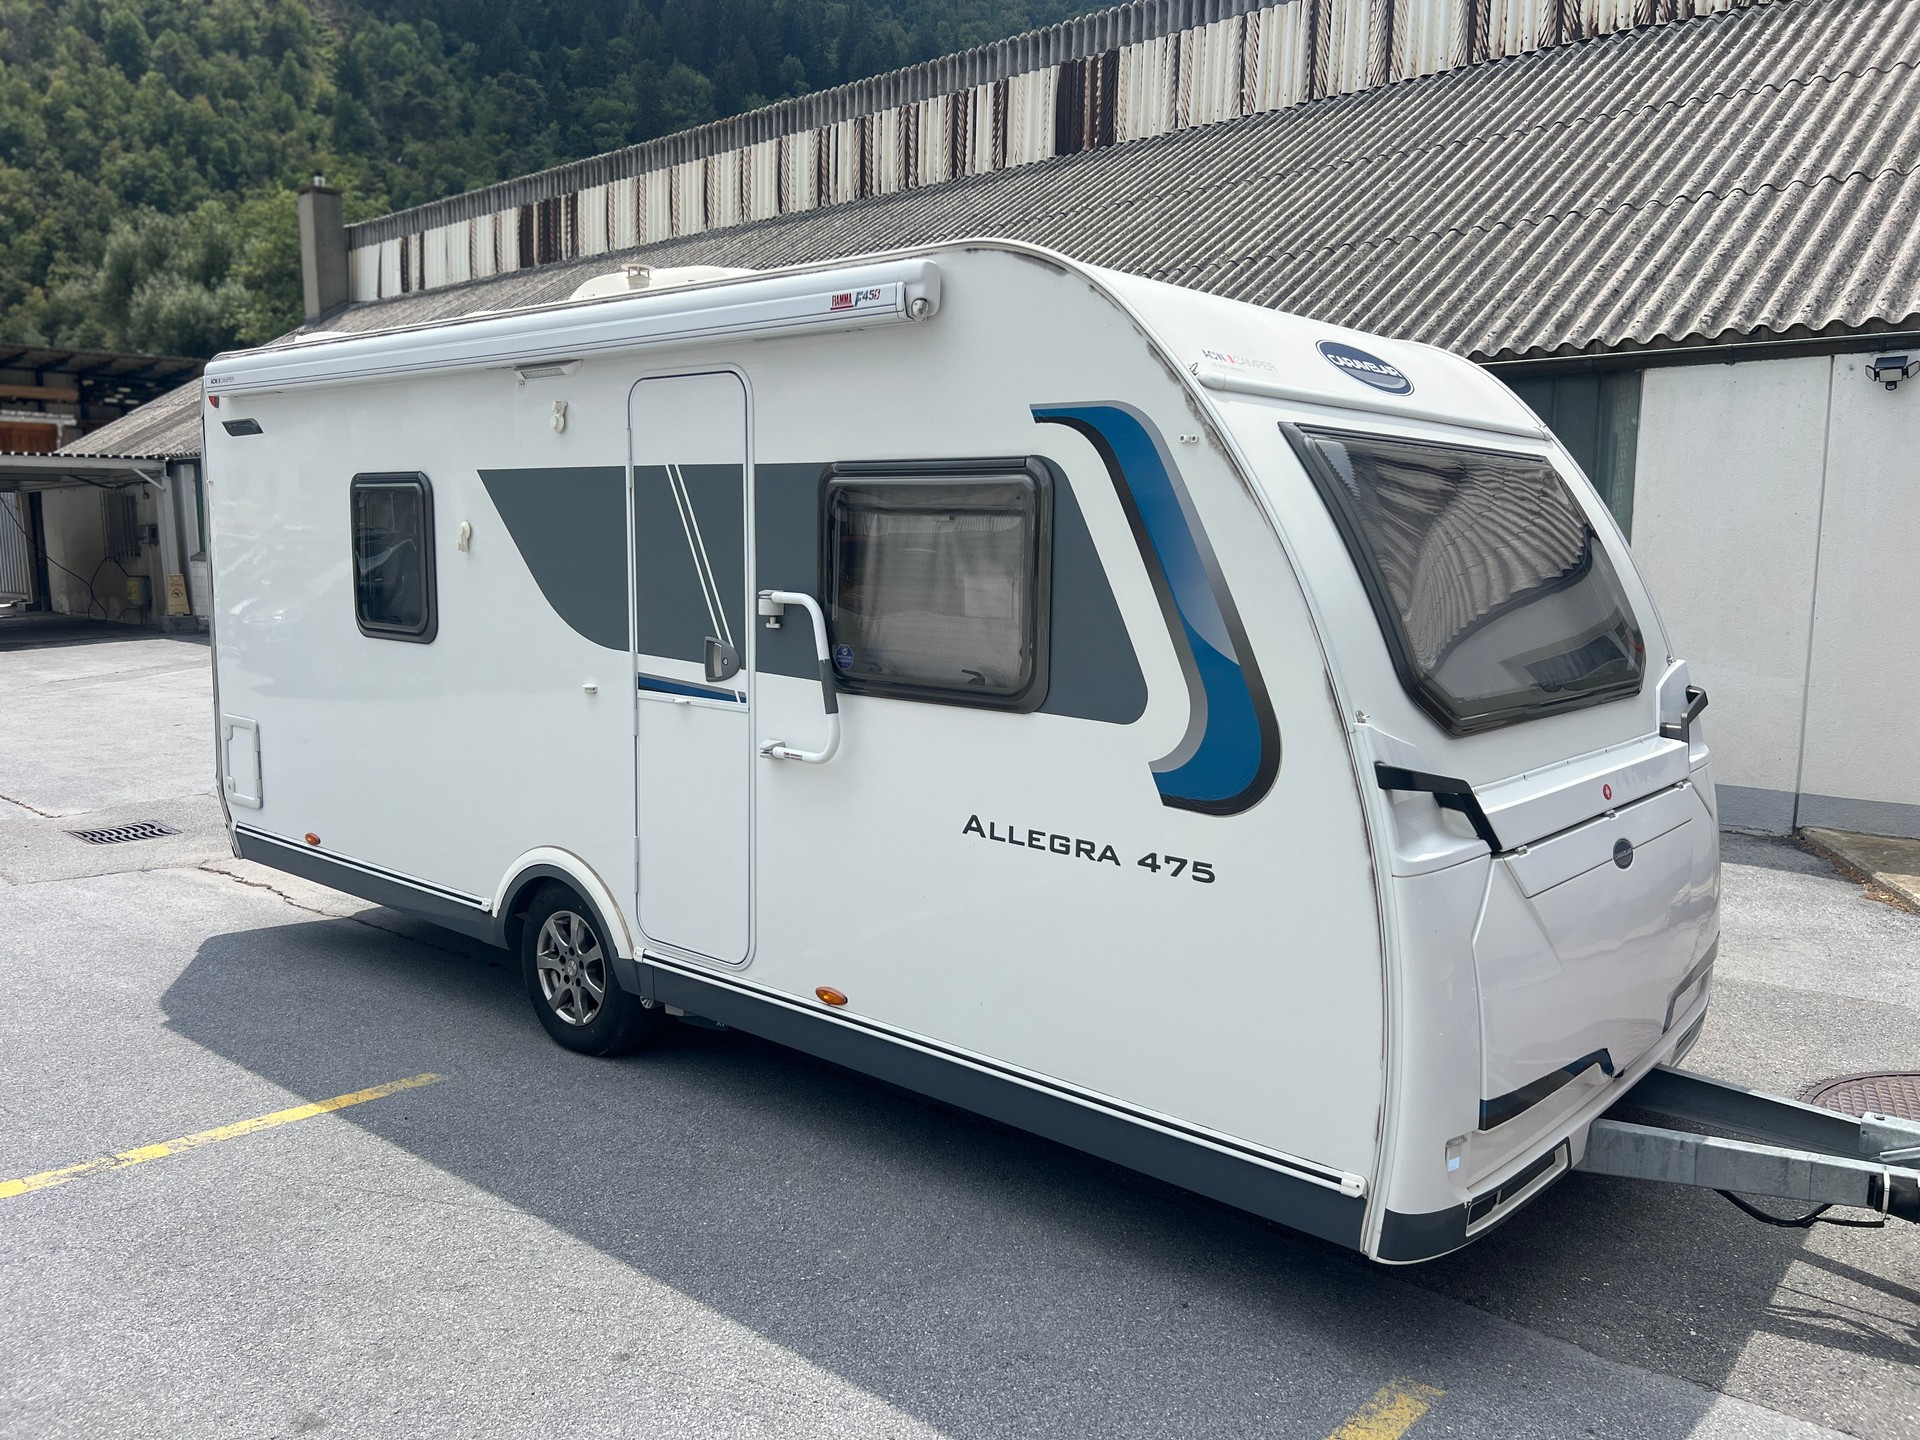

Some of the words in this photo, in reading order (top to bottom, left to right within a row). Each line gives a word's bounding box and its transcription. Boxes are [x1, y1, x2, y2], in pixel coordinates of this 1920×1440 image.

[831, 293, 853, 308] FIAMMA
[962, 814, 1121, 867] ALLEGRA
[1137, 852, 1216, 884] 475
